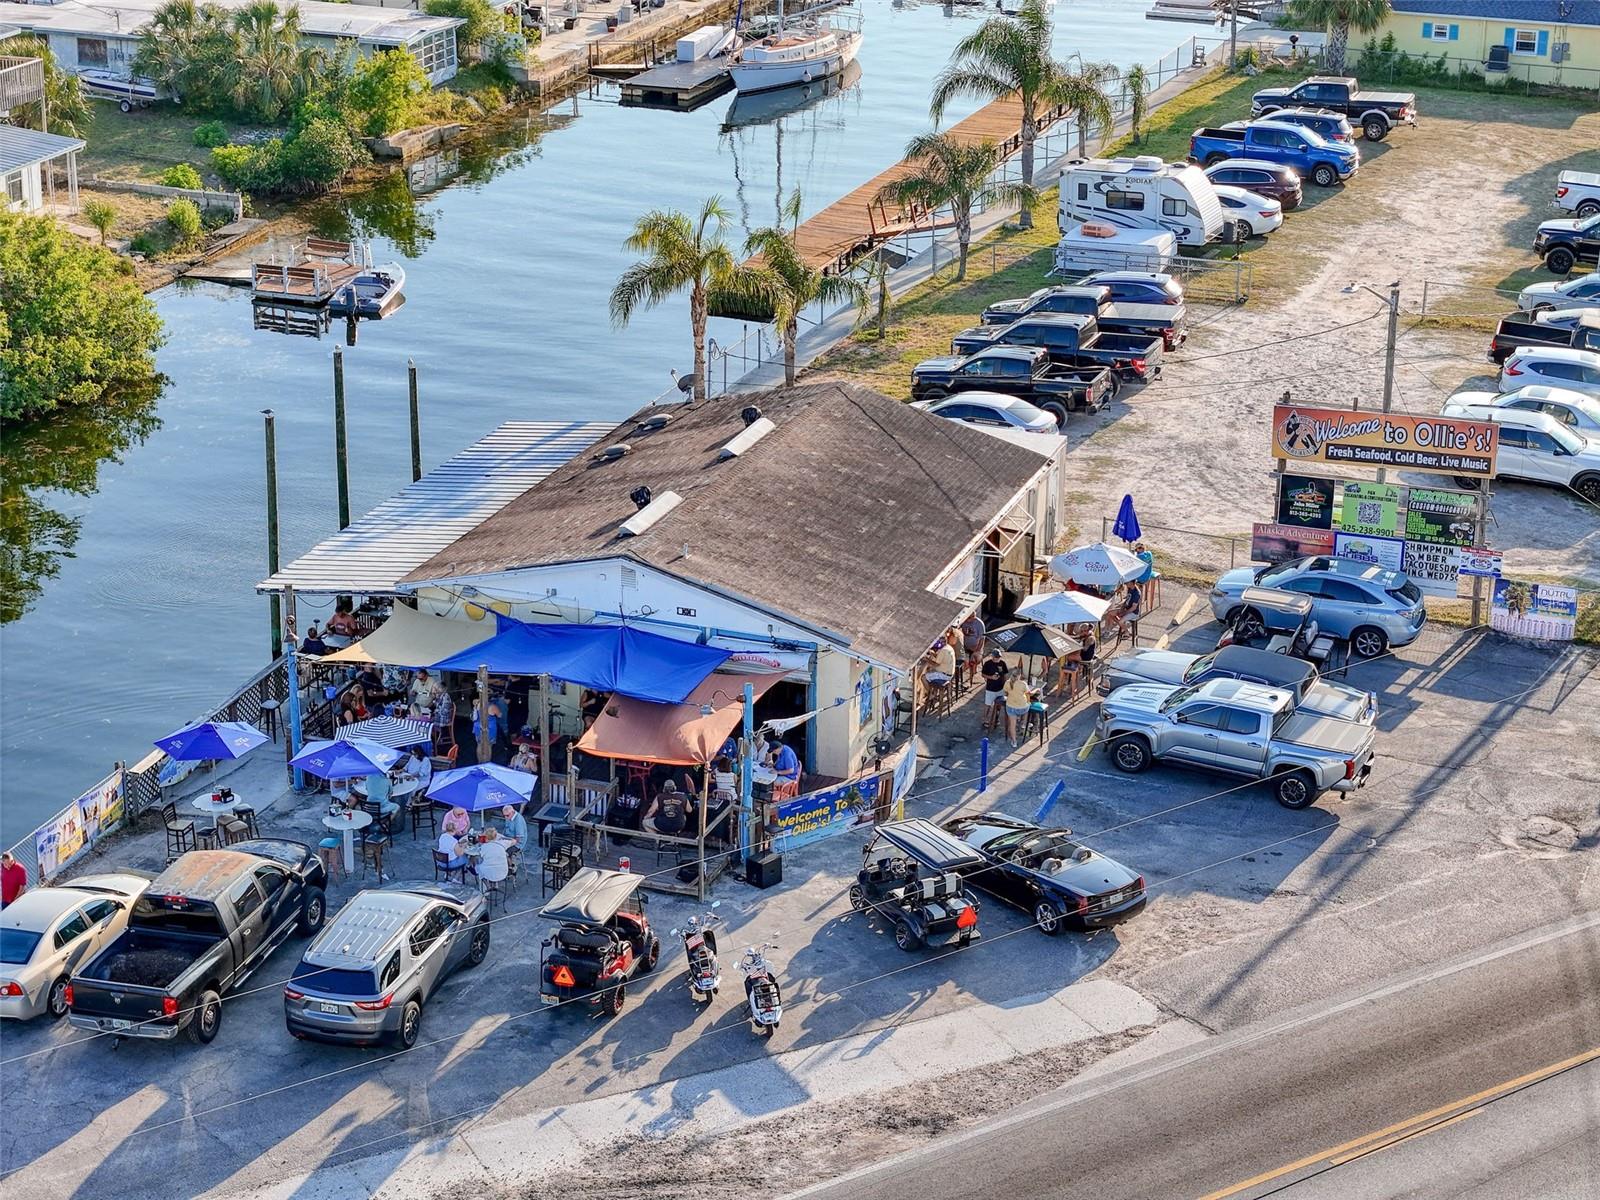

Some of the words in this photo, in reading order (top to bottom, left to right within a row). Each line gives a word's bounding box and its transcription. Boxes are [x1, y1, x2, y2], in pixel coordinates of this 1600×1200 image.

[1125, 176, 1153, 185] KODIAK
[1315, 415, 1382, 442] Welcome
[1384, 421, 1408, 443] to
[1414, 421, 1493, 452] Ollie's!
[1328, 446, 1353, 459] Fresh
[1355, 448, 1393, 462] Seafood,
[1395, 452, 1415, 464] Cold
[1417, 455, 1439, 467] Beer,
[1441, 456, 1459, 468] Live
[1461, 458, 1488, 471] Music
[1258, 526, 1285, 536] Alaska
[1286, 529, 1329, 541] Adventure
[1406, 568, 1424, 578] ING
[777, 806, 831, 828] Welcome
[834, 799, 849, 812] To
